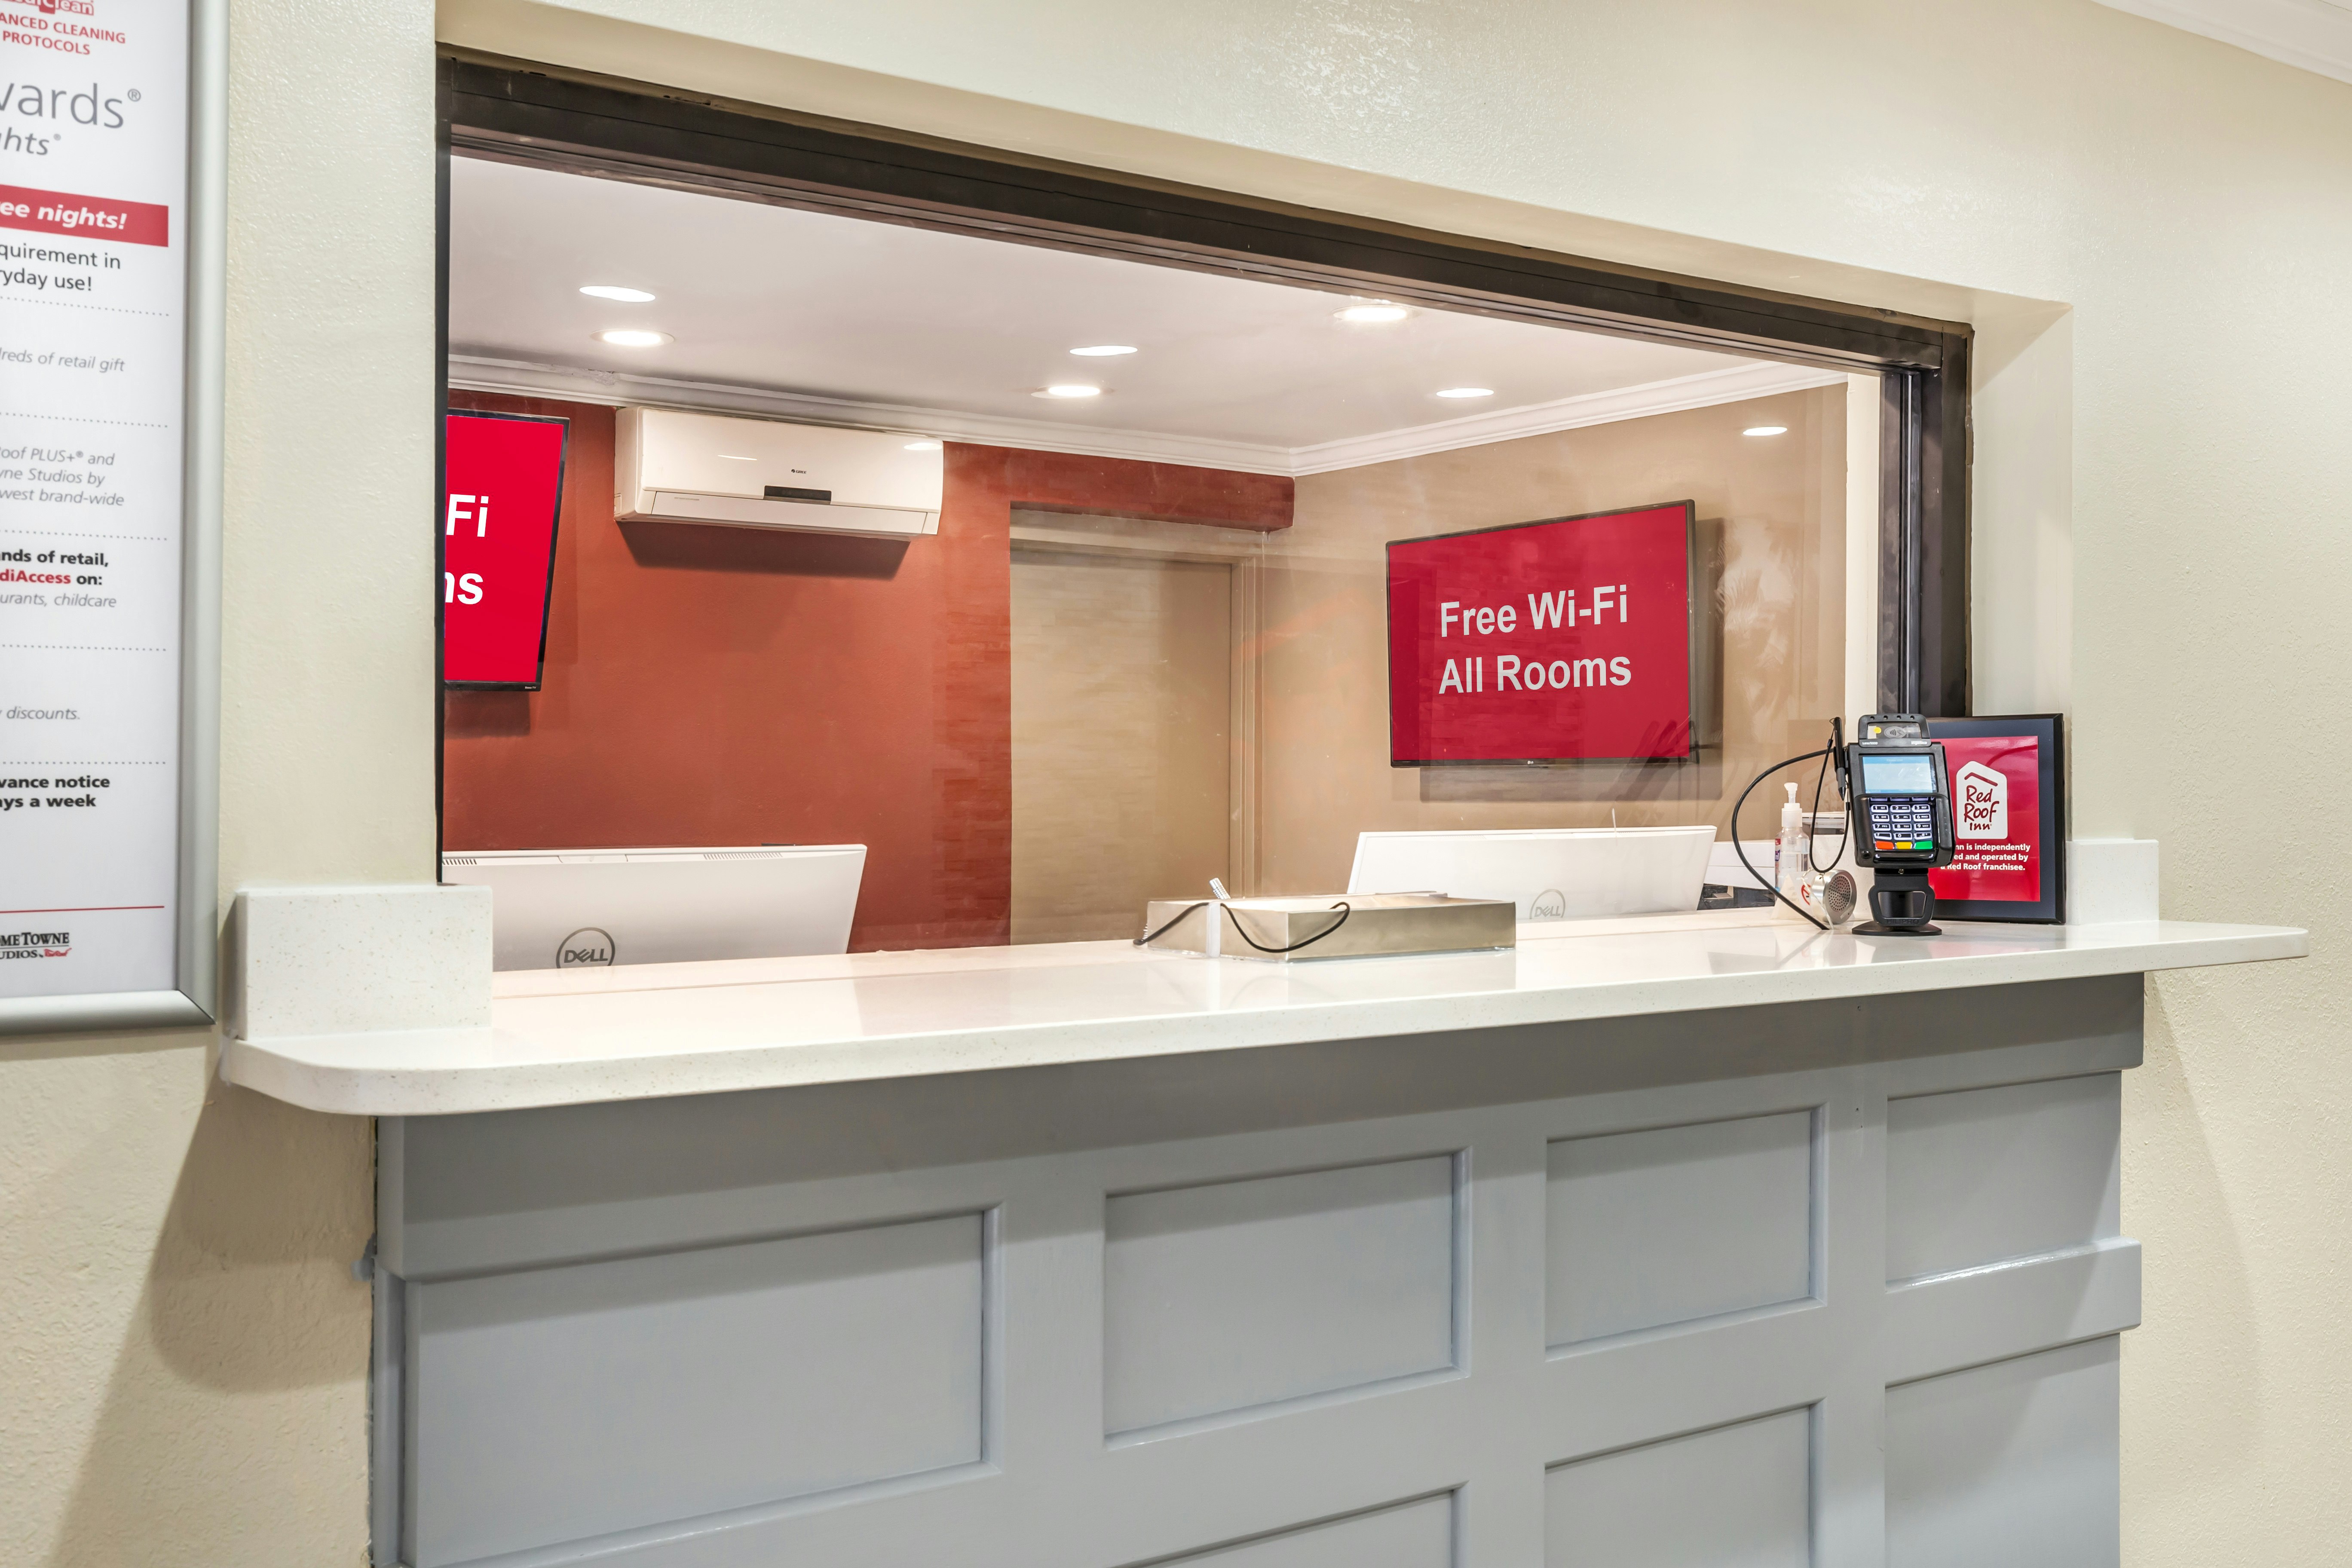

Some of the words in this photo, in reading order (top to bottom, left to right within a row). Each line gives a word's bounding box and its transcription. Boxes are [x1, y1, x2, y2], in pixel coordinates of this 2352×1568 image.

[53, 21, 126, 43] CLEANING
[3, 31, 90, 55] PROTOCOLS
[37, 204, 127, 230] nights!
[104, 252, 121, 269] in
[55, 276, 92, 291] use!
[0, 347, 33, 363] reds
[38, 352, 55, 364] of
[58, 356, 96, 368] retail
[99, 358, 126, 373] gift
[0, 447, 27, 459] oof
[88, 453, 115, 466] and
[28, 468, 83, 484] Studios
[87, 472, 105, 487] by
[39, 488, 124, 506] brand-wide
[37, 551, 55, 563] of
[61, 553, 108, 567] retail,
[76, 575, 102, 585] on:
[54, 593, 116, 607] childcare
[1441, 601, 1516, 637] Free
[1528, 584, 1627, 630] Wi-Fi
[1438, 656, 1482, 694] All
[1497, 654, 1632, 691] Rooms
[6, 706, 80, 720] discounts.
[55, 775, 110, 788] notice
[0, 797, 23, 811] ys
[30, 798, 40, 807] a
[46, 794, 96, 807] week
[1966, 785, 1993, 803] Red
[1964, 801, 2000, 822] Roof
[1975, 843, 2030, 852] independently
[2018, 854, 2028, 862] by
[1534, 906, 1561, 917] DELL
[564, 948, 608, 963] DELL
